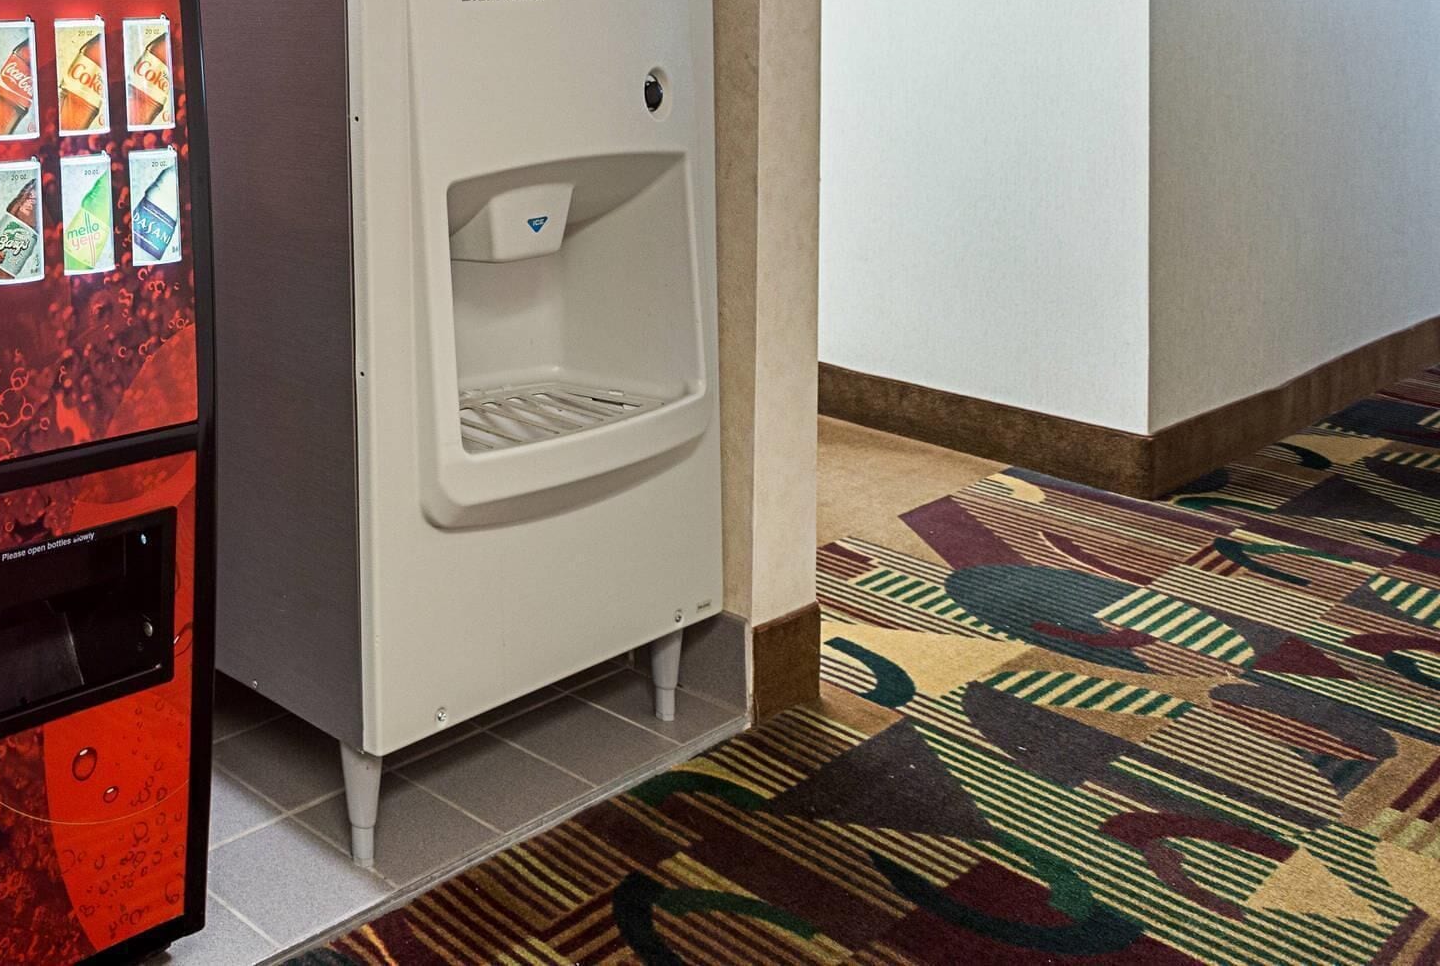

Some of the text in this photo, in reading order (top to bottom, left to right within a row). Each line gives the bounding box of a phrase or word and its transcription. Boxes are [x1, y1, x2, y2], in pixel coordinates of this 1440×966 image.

[70, 63, 103, 95] Coke
[136, 60, 169, 92] Coke
[67, 212, 99, 240] mello
[133, 212, 171, 244] DASANI
[532, 219, 545, 227] ICE
[1, 550, 26, 562] Please
[27, 544, 46, 555] open
[47, 537, 71, 550] bottles
